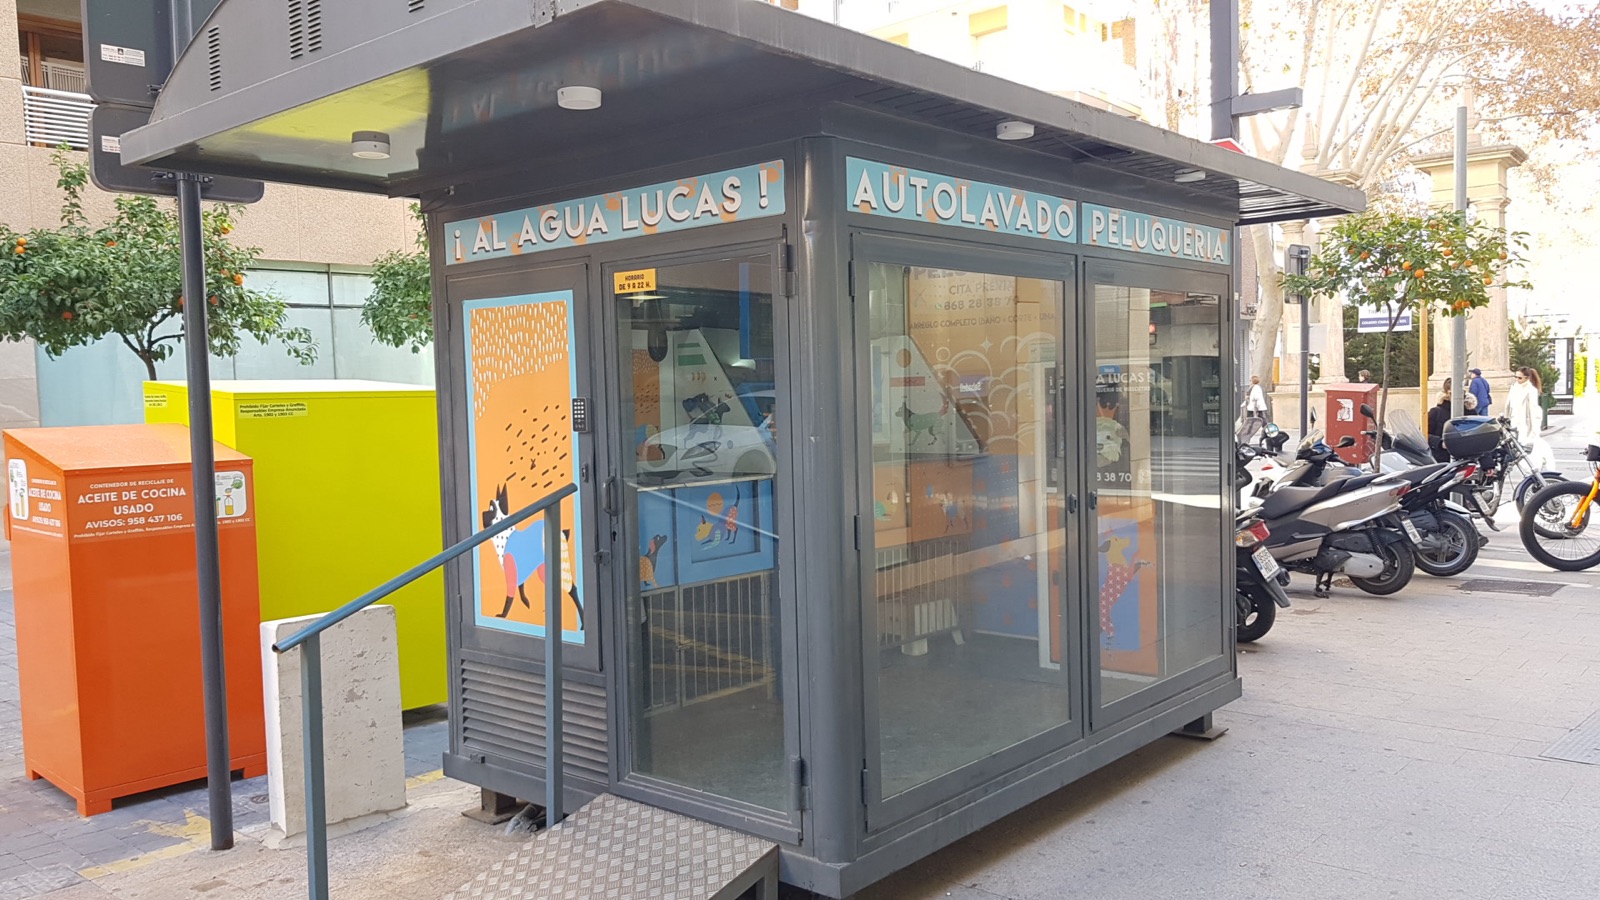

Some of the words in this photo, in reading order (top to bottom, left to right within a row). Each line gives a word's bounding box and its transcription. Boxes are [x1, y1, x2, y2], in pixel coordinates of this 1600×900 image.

[472, 220, 507, 254] AL
[518, 201, 608, 248] AGUA
[621, 176, 742, 231] LUCAS
[853, 168, 1075, 238] AUTOLAVADO
[1091, 210, 1224, 262] PELUQUERIA
[949, 284, 972, 295] CITA
[944, 301, 964, 310] 868
[968, 299, 982, 308] 28
[940, 318, 977, 327] COMPLETO
[1108, 372, 1144, 384] LUCAS
[1104, 472, 1116, 481] 38
[1118, 473, 1132, 482] 70
[78, 492, 118, 504] ACEITE
[122, 490, 137, 500] DE
[141, 487, 186, 499] COCINA
[114, 503, 154, 515] USADO
[85, 519, 125, 529] AVISOS:
[127, 517, 145, 525] 958
[148, 515, 165, 523] 437
